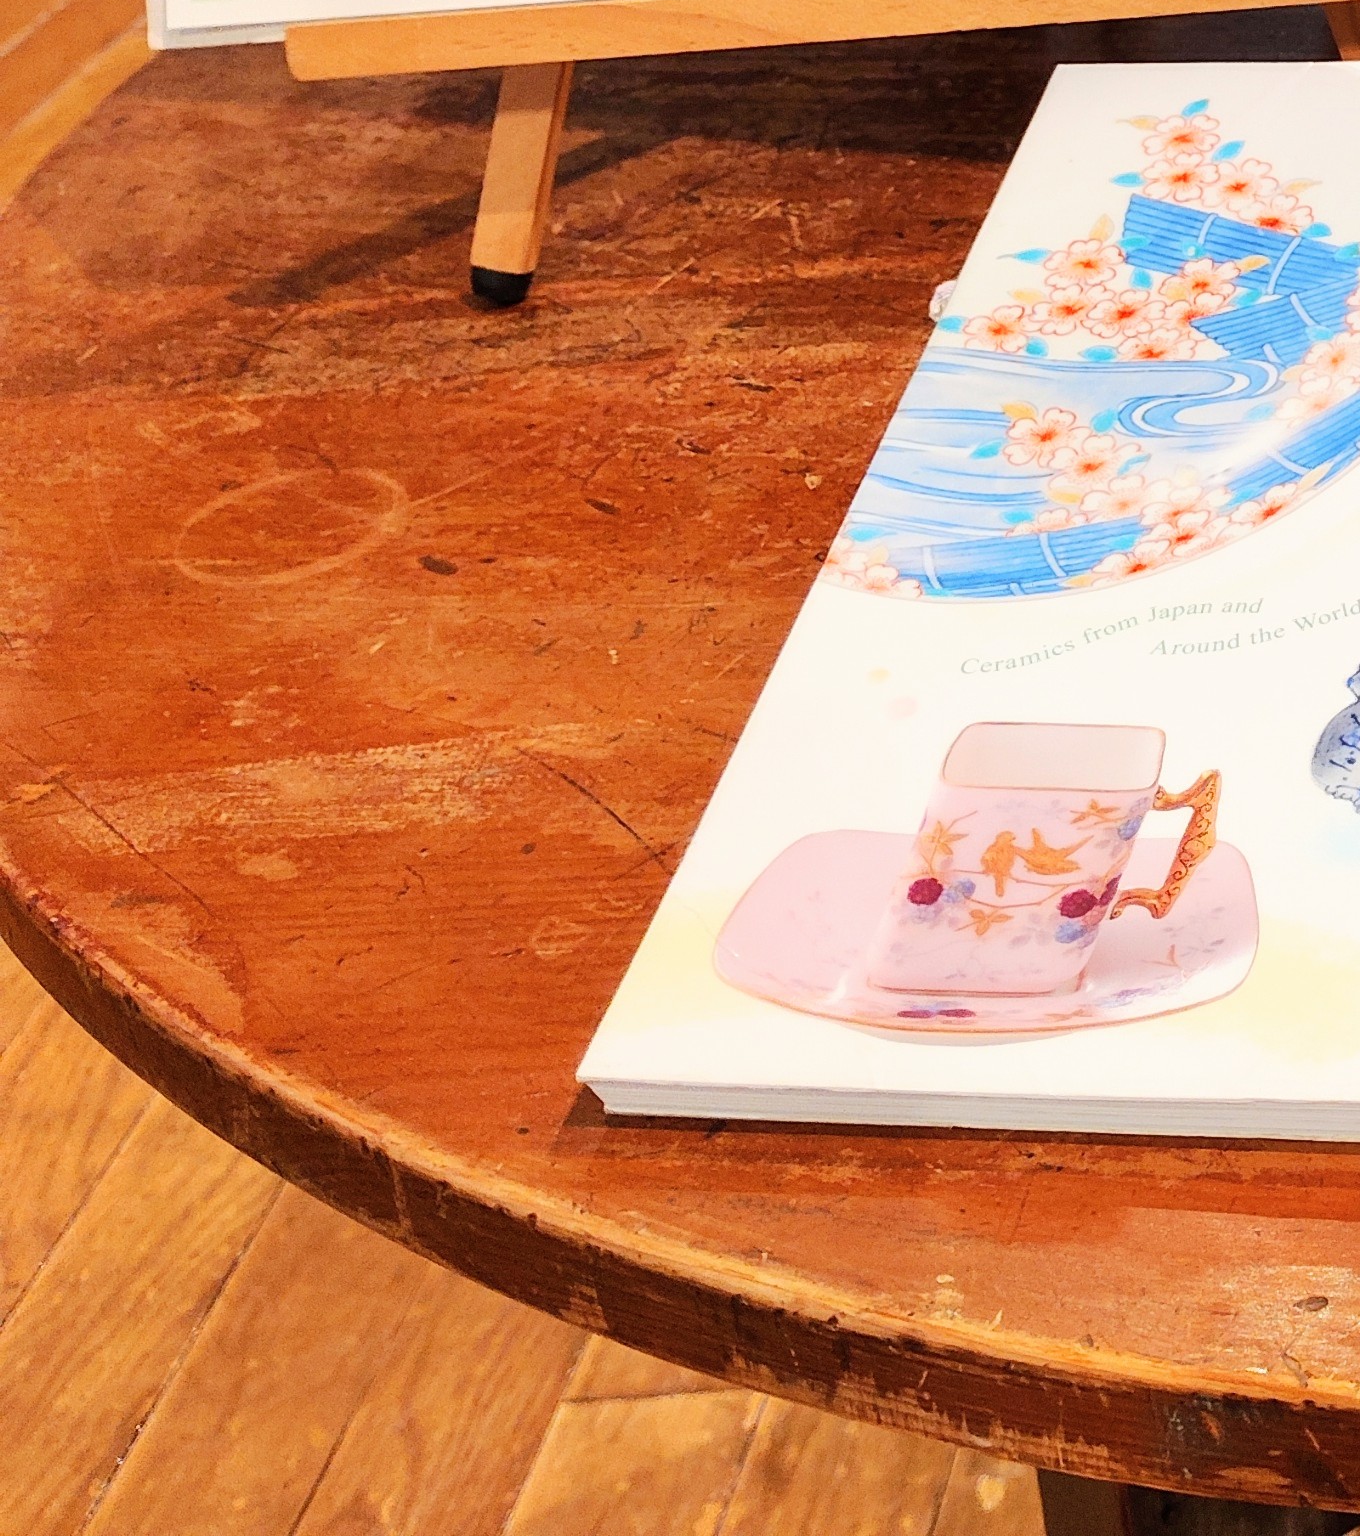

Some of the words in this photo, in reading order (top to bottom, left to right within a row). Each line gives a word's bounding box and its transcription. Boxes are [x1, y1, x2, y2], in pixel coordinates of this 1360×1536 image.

[960, 637, 1077, 677] Ceramics
[1081, 613, 1140, 646] from
[1147, 597, 1214, 624] Japan
[1220, 594, 1265, 617] and
[1148, 632, 1243, 658] Around
[1248, 622, 1286, 645] the
